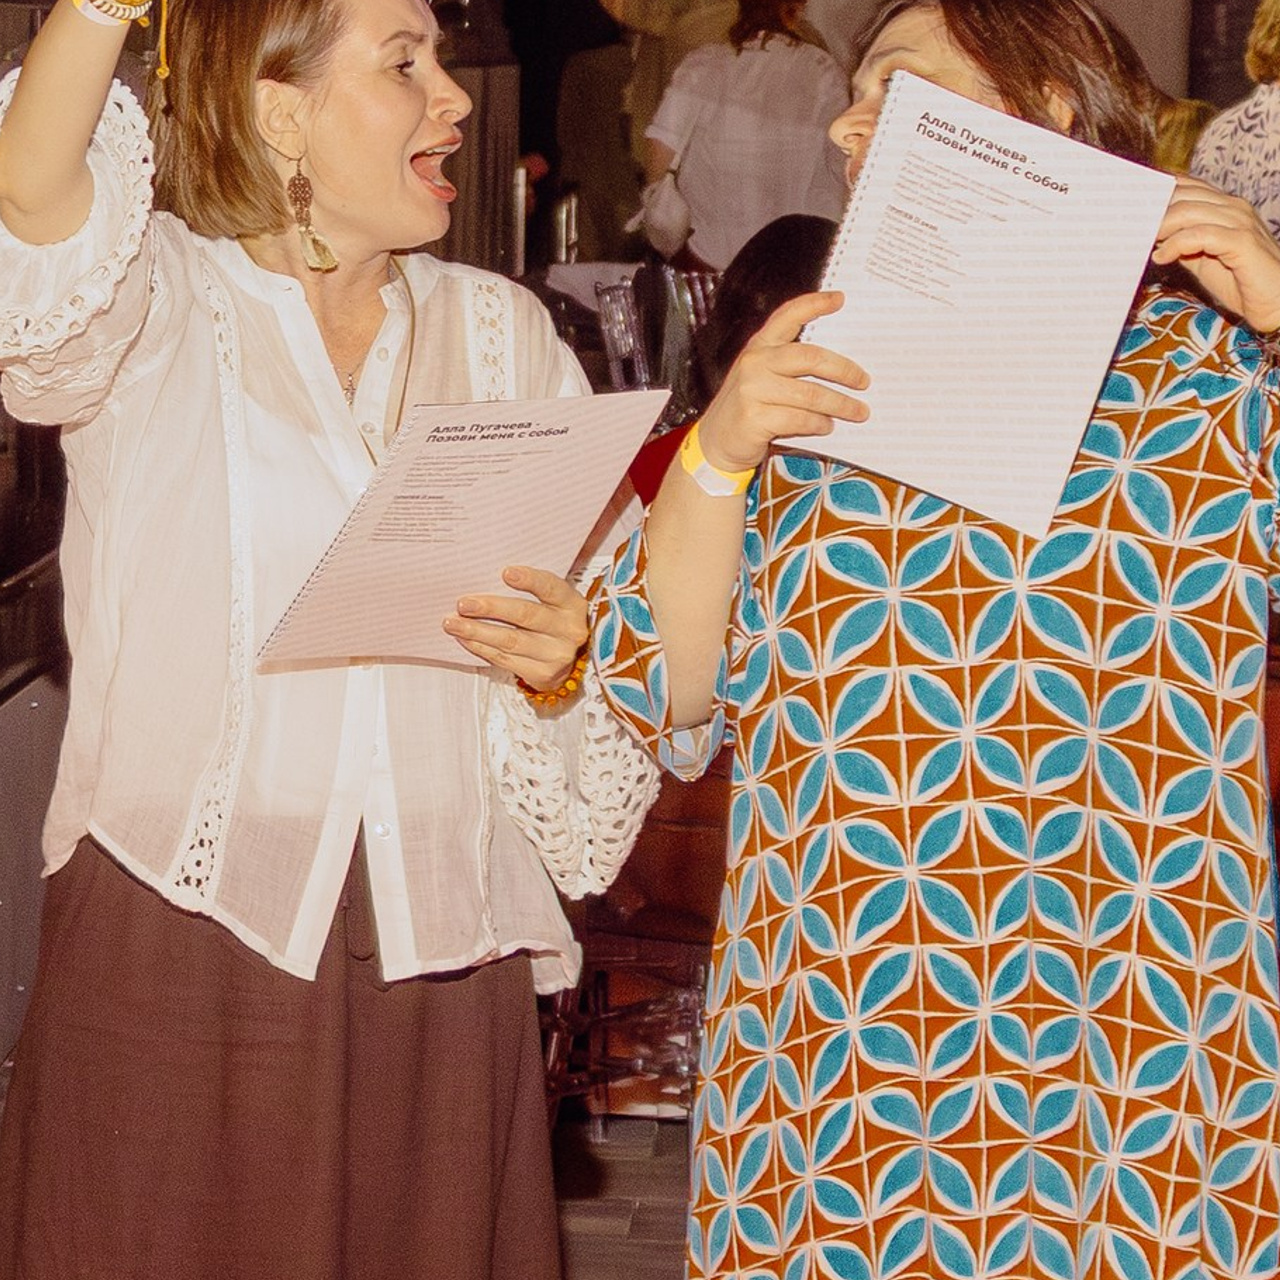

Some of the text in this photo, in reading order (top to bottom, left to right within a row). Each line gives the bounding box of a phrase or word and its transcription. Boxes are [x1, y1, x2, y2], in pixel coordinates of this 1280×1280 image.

[920, 112, 956, 134] Алла
[960, 128, 1028, 163] Пугачева
[916, 123, 1070, 195] Позови меня с собой
[425, 434, 477, 443] Позови
[479, 432, 514, 441] меня
[528, 426, 570, 438] собой
[430, 425, 466, 434] Алла
[469, 421, 532, 433] Пугачева
